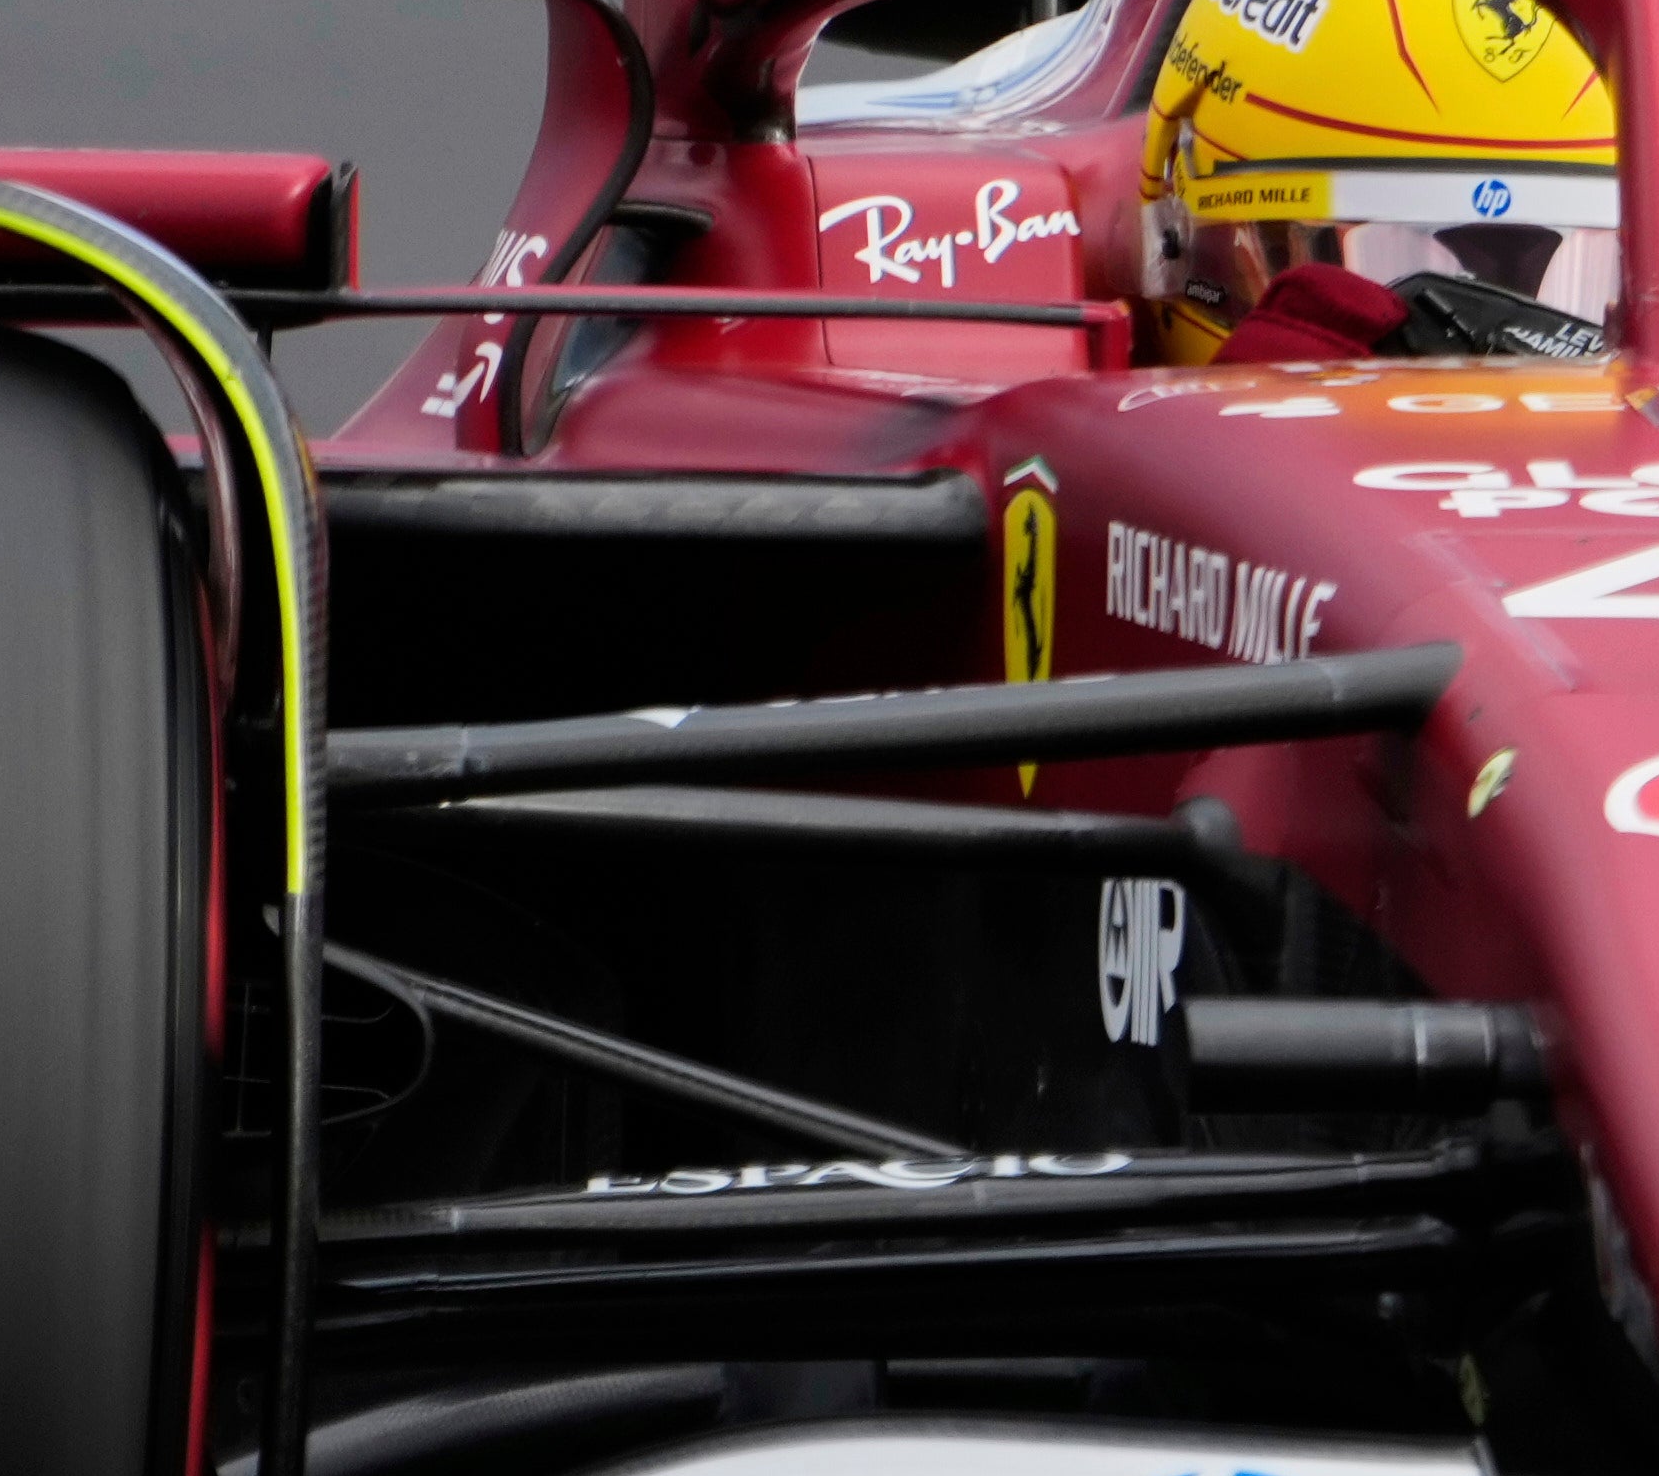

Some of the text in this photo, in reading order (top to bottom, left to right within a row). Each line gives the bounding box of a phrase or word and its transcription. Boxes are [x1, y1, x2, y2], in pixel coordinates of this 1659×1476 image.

[1198, 187, 1310, 210] RICHARD MILLE
[1474, 180, 1511, 217] hp
[1106, 521, 1229, 652] RICHARD
